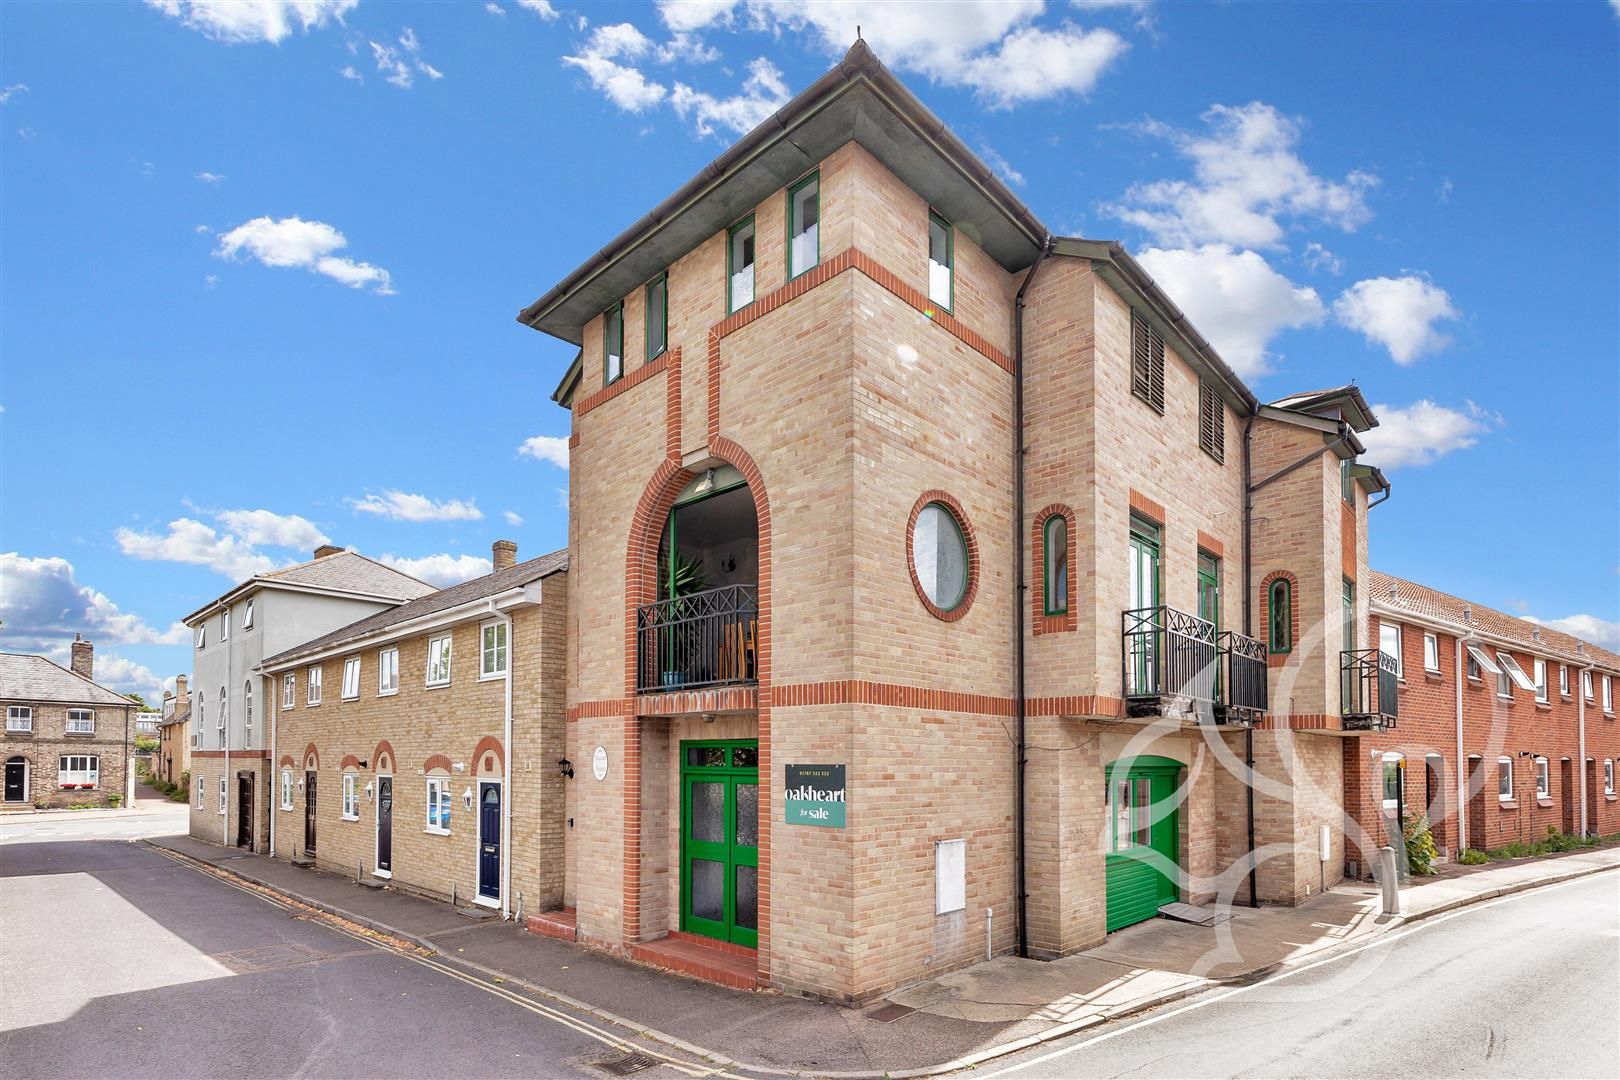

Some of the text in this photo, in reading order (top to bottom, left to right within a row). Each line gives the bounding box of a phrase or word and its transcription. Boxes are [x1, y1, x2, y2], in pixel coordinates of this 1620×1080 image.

[784, 785, 846, 802] oakheart
[800, 807, 829, 820] for sale
